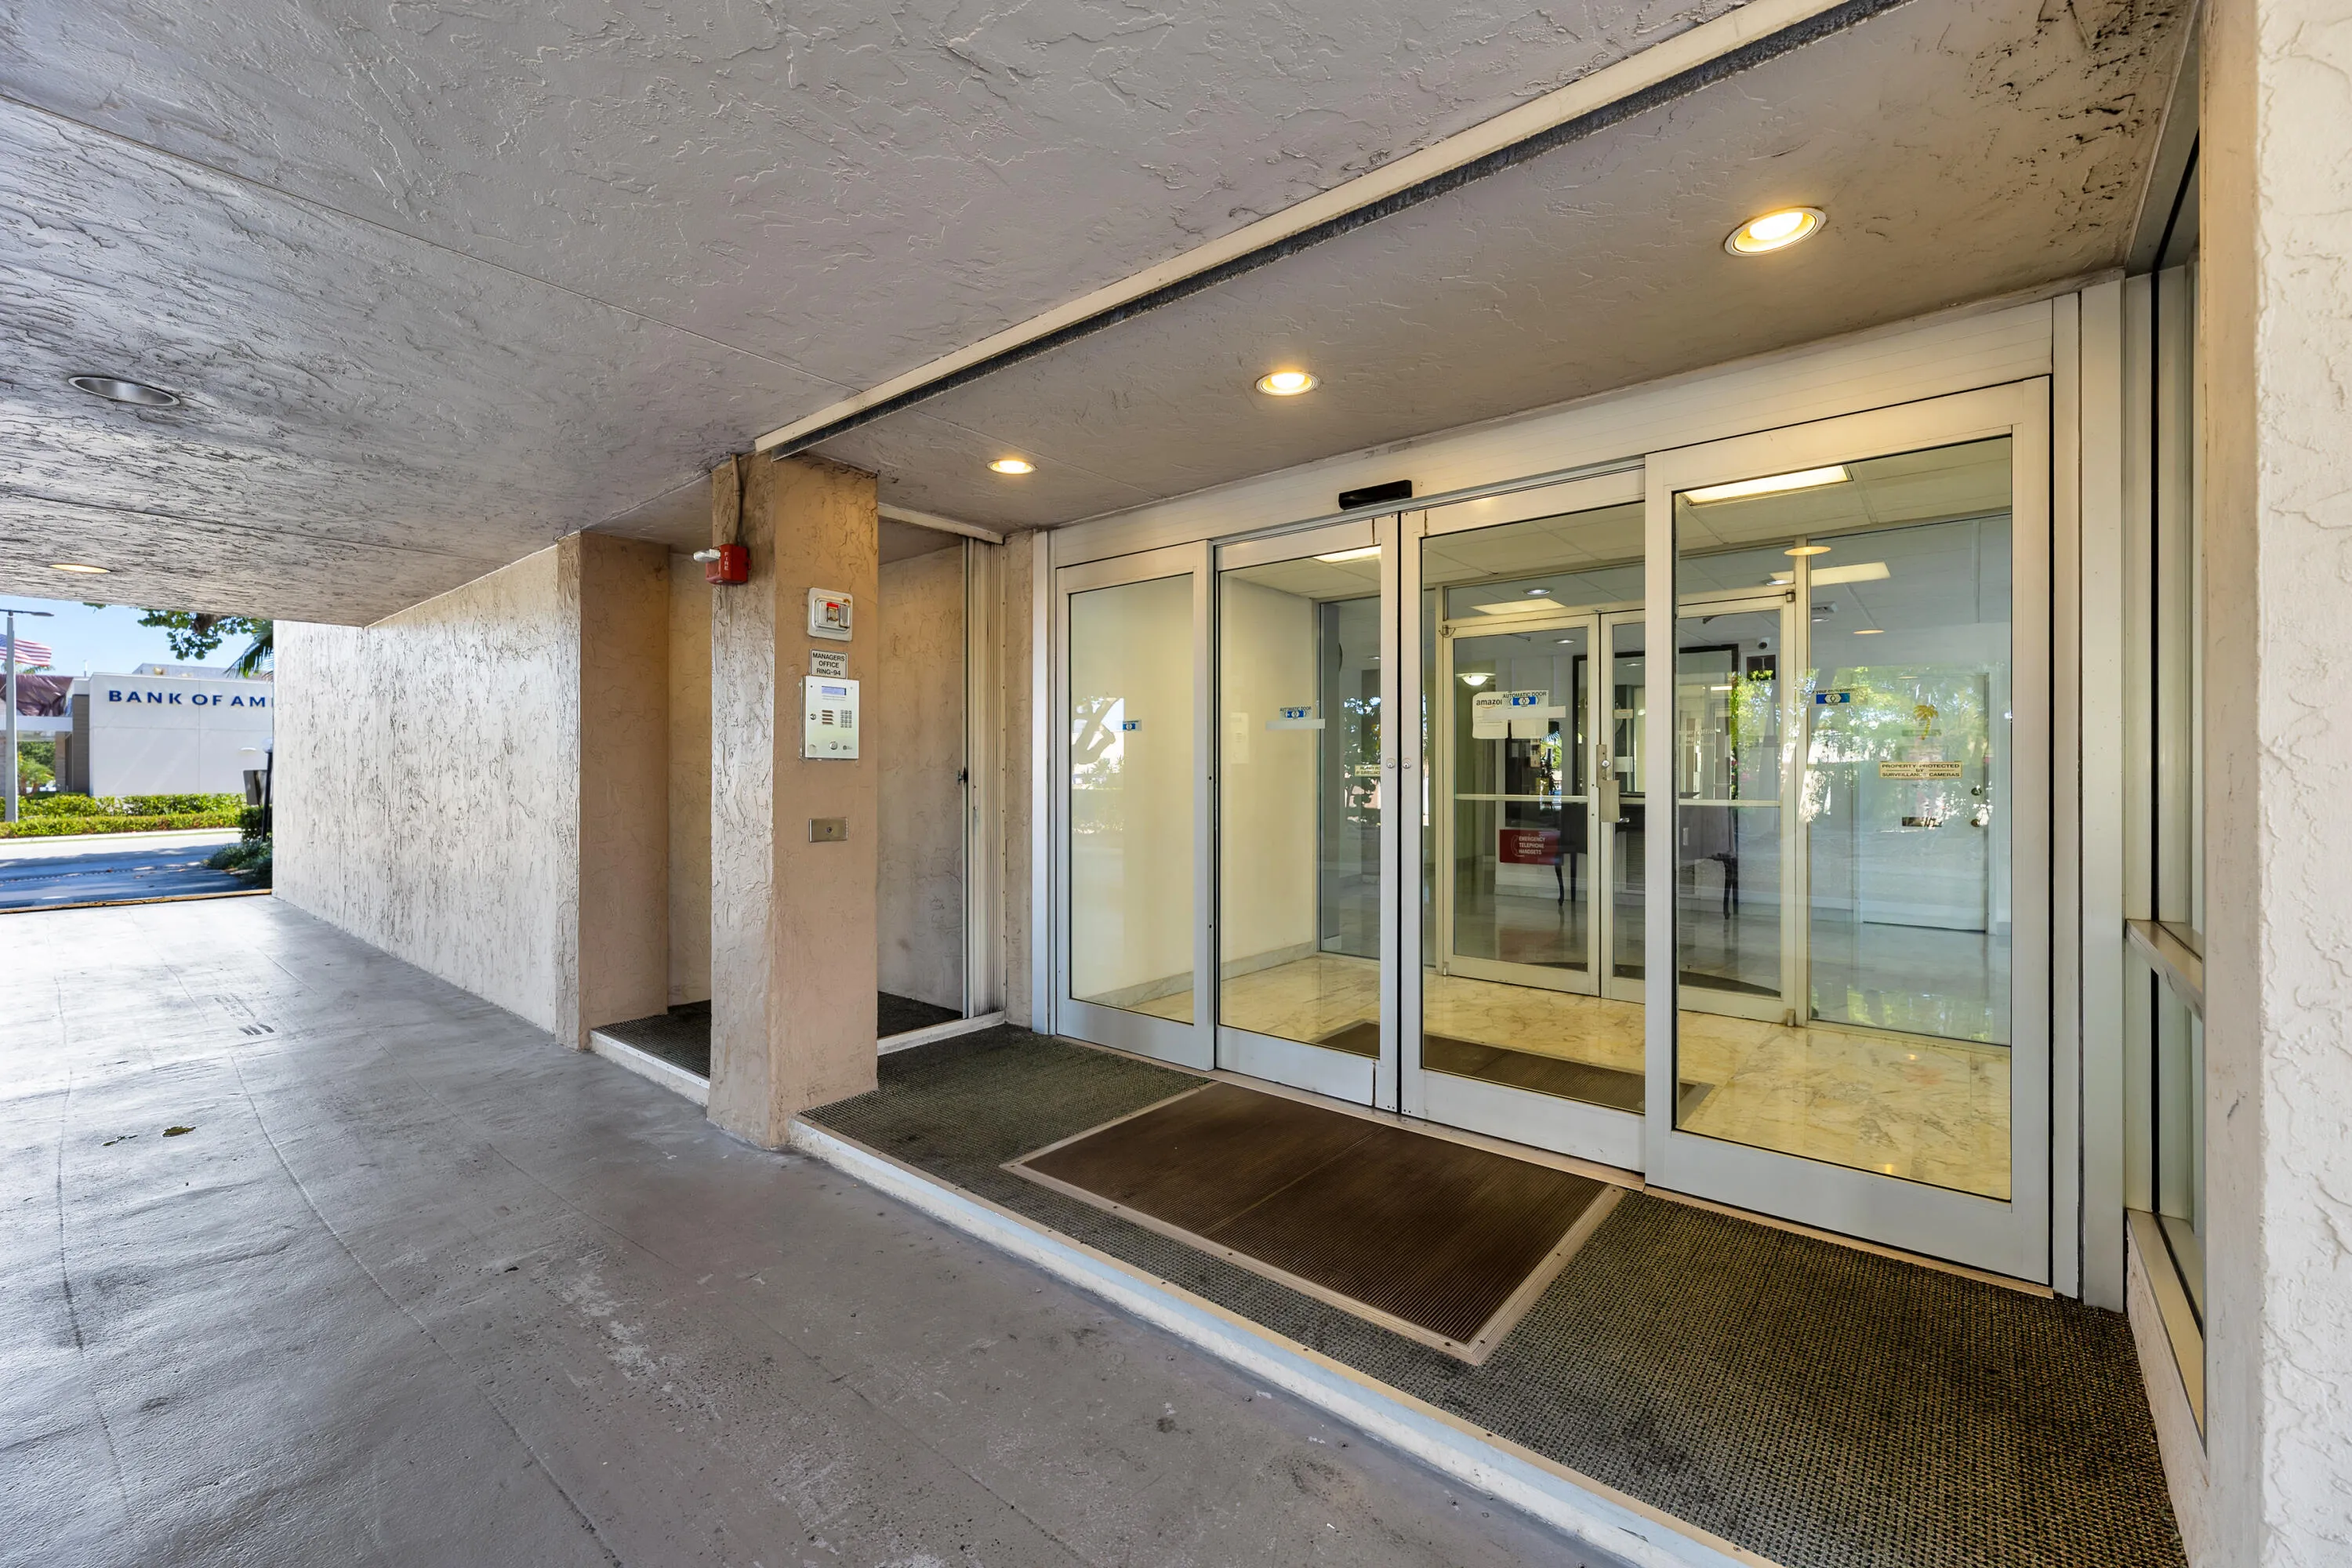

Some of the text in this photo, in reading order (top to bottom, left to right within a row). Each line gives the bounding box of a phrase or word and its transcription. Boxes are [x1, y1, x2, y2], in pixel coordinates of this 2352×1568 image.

[812, 652, 845, 662] MANAGERS
[108, 690, 274, 708] BANK OF AM
